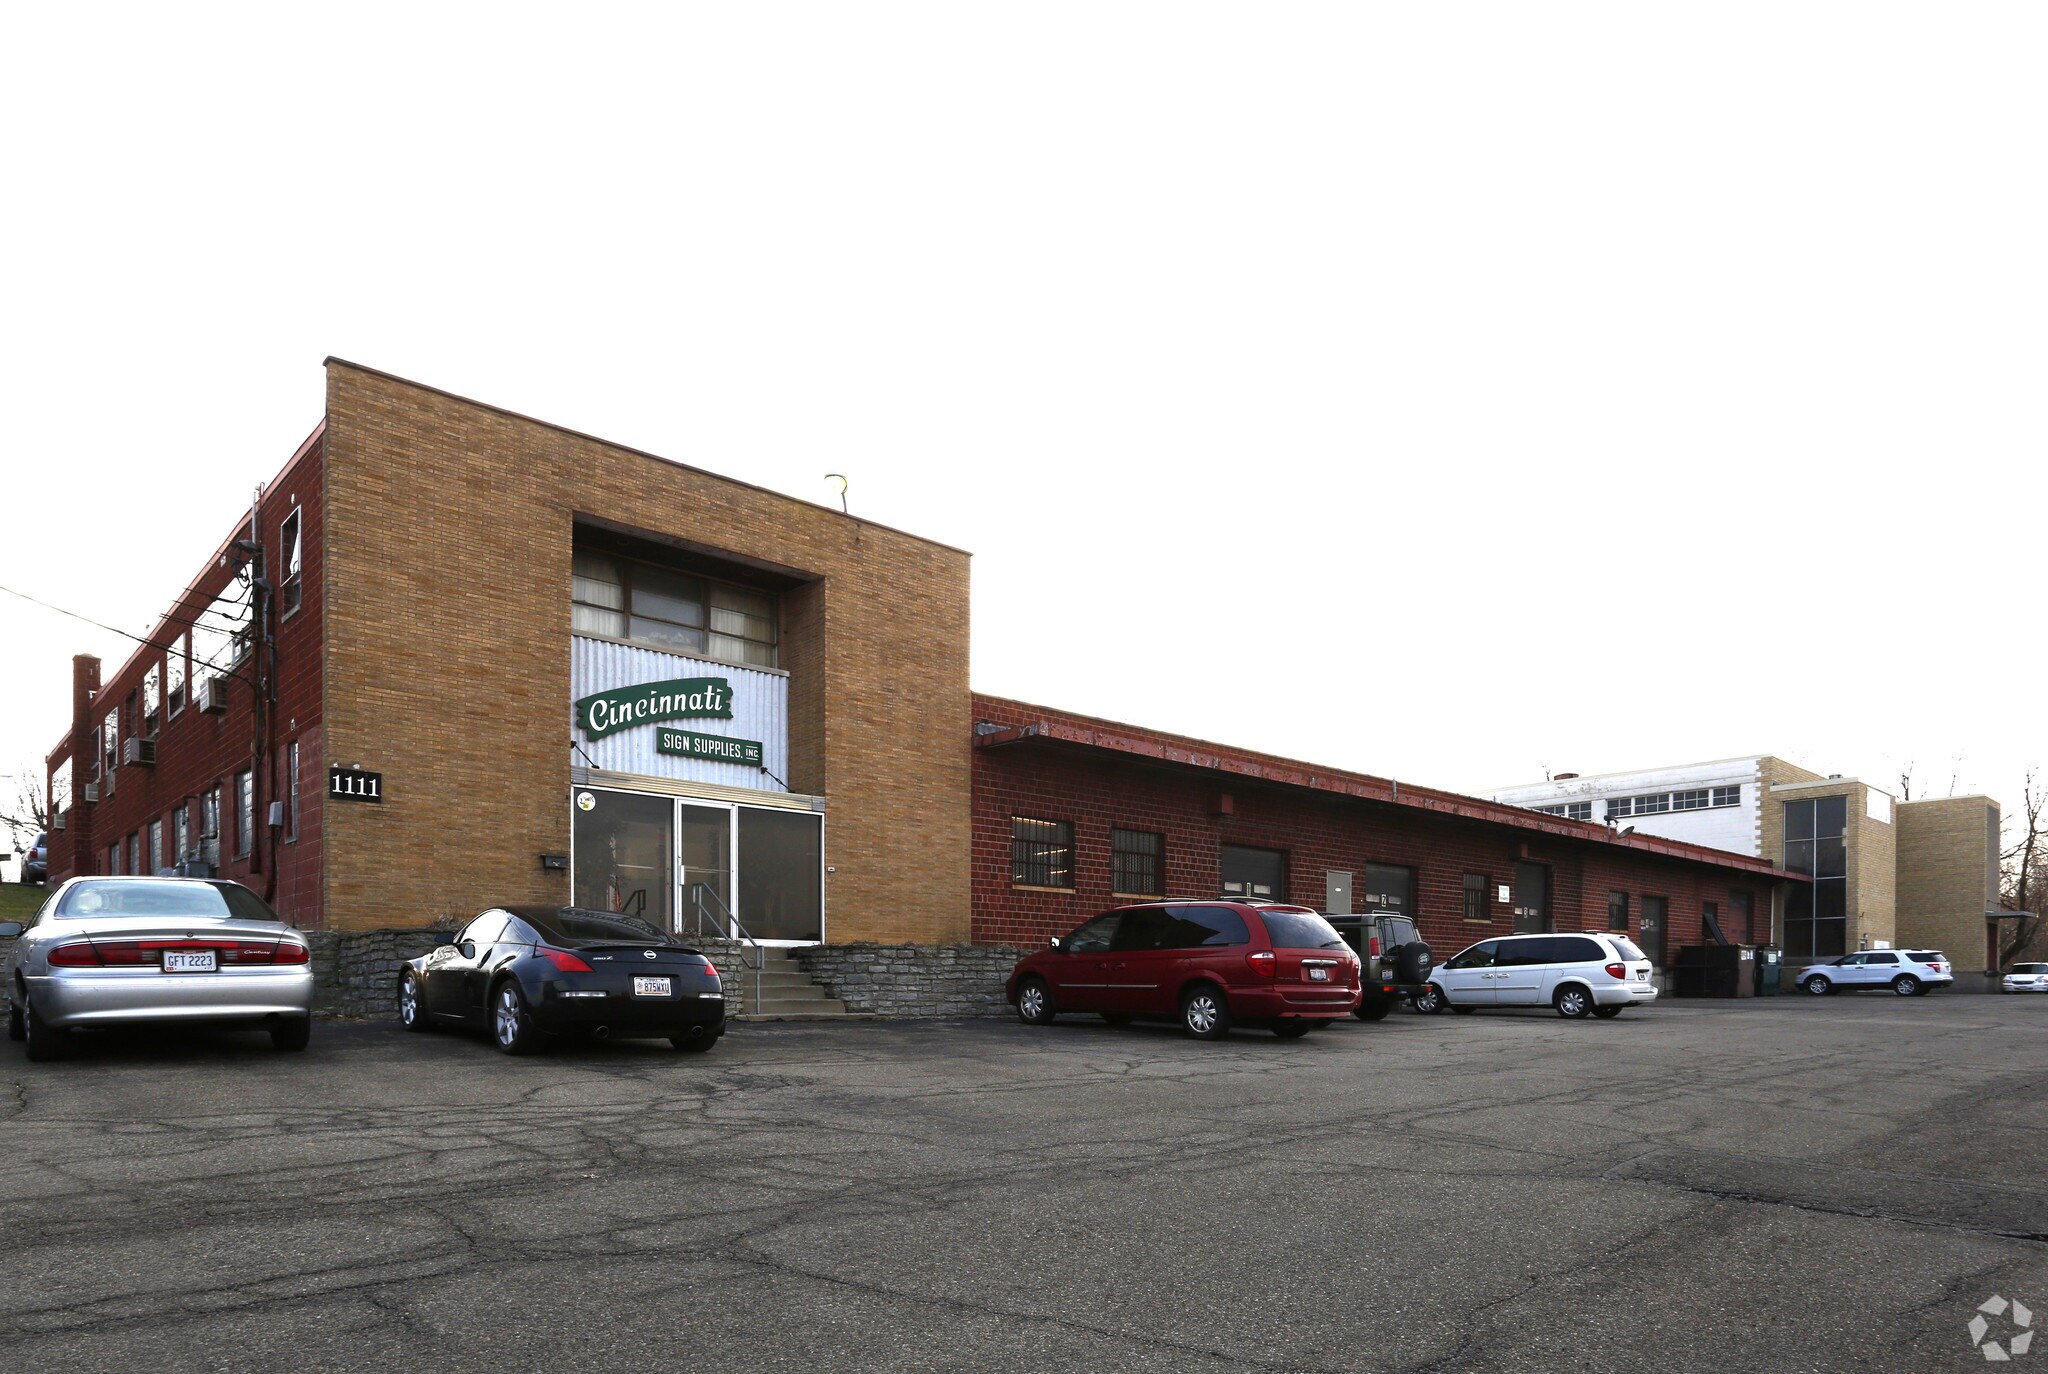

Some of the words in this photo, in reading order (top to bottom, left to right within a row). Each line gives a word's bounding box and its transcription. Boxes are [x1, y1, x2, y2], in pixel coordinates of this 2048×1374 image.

[589, 685, 723, 731] Cincinnati
[663, 733, 690, 751] SIGN
[745, 748, 760, 758] INC.
[332, 774, 379, 797] 1111
[168, 956, 185, 966] GFT
[188, 955, 212, 966] 2223
